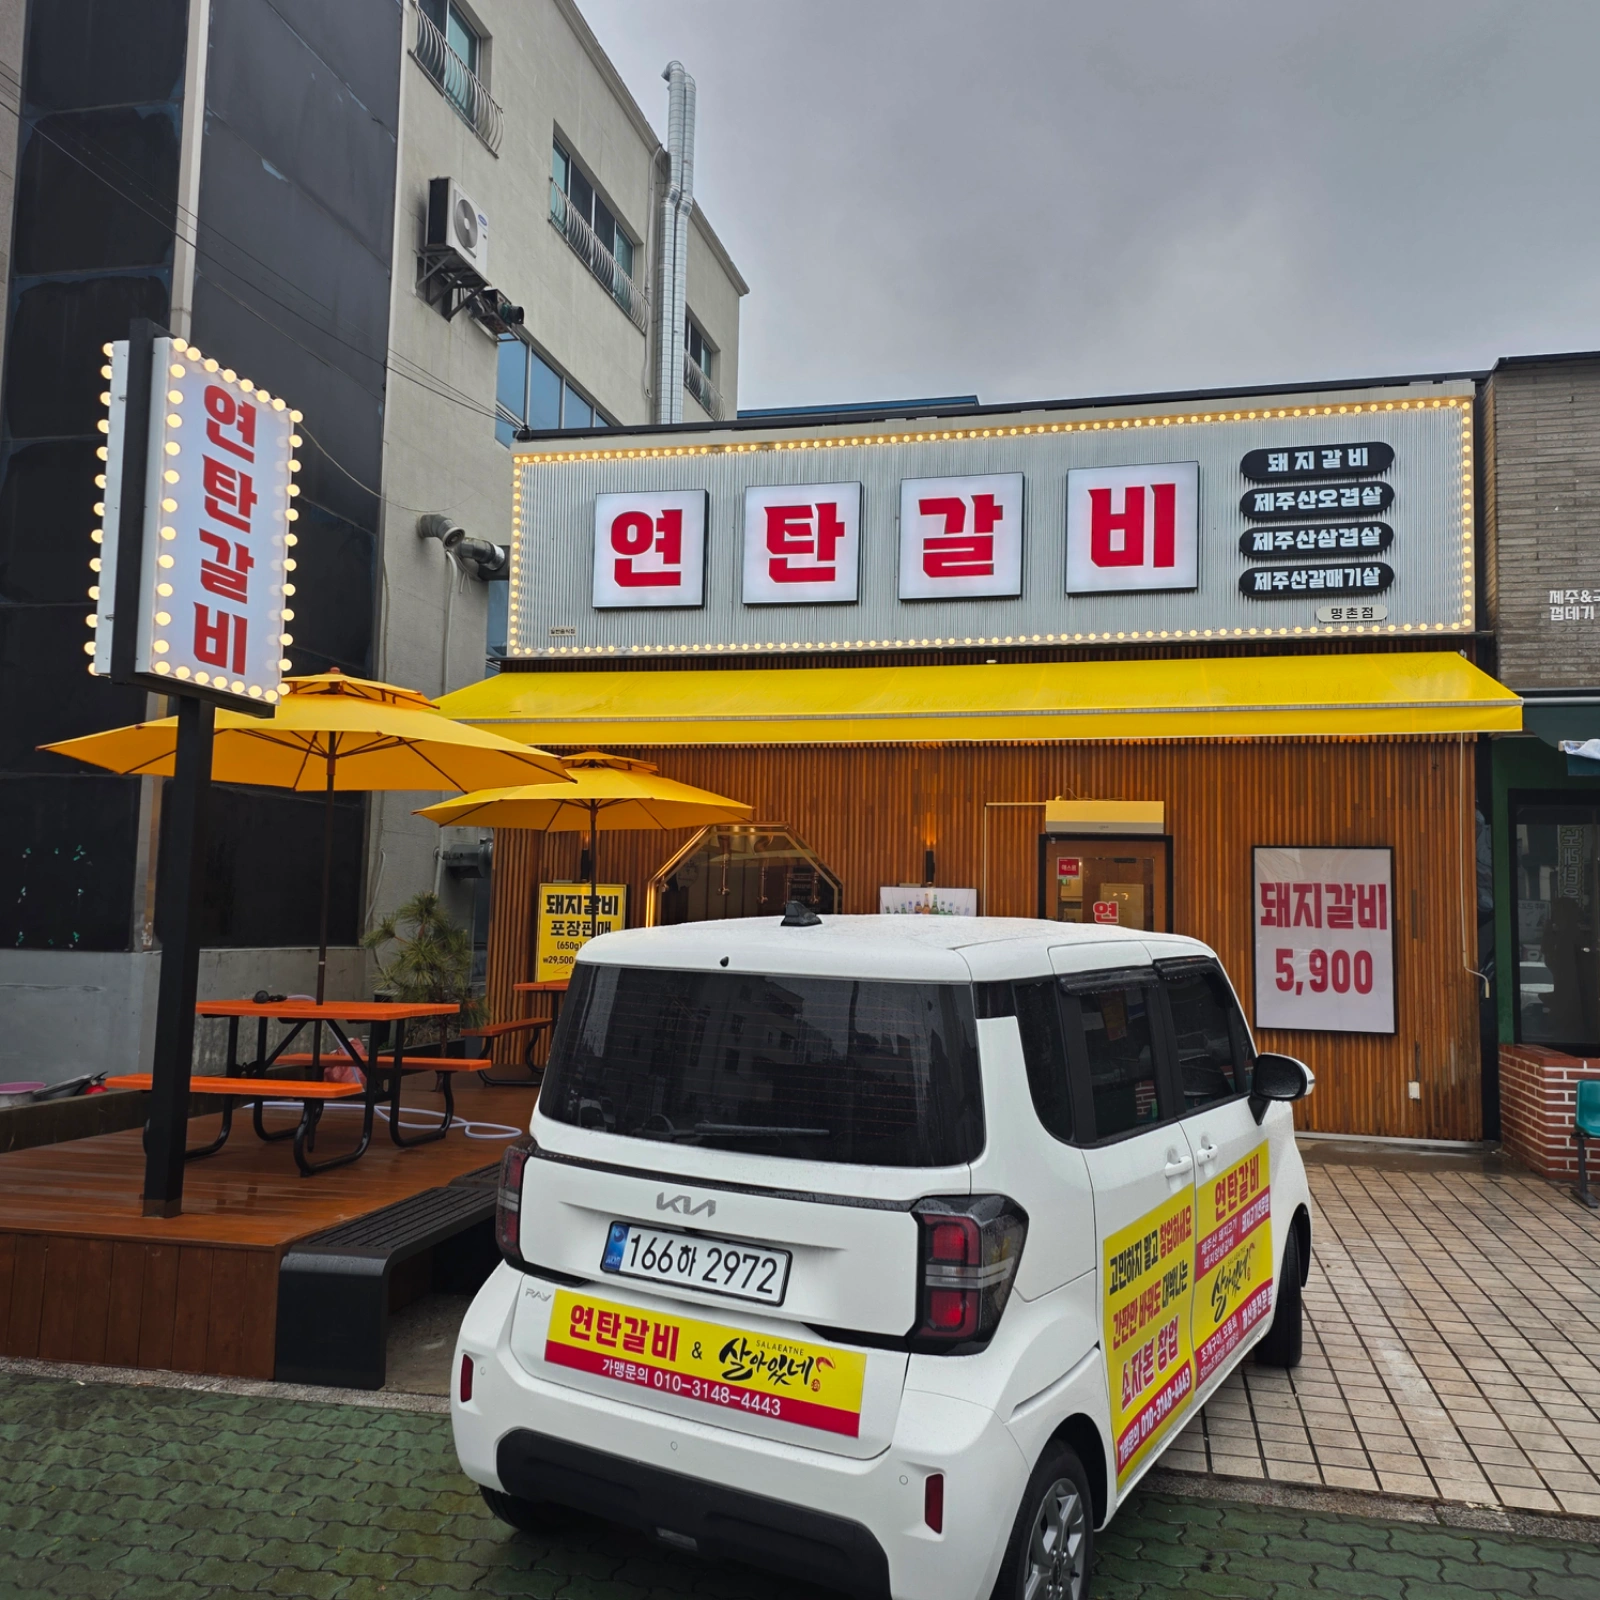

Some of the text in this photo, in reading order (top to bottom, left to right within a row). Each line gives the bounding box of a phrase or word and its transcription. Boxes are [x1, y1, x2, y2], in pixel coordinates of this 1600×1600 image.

[1267, 447, 1369, 472] 돼지갈비
[1254, 486, 1382, 512] 제주산오겹살
[192, 383, 258, 677] 연탄갈비
[610, 482, 1176, 588] 연탄갈비
[1252, 526, 1382, 551] 제주산삼겹살
[1254, 567, 1381, 591] 제주산갈매기살
[1331, 607, 1373, 619] 명촌점
[1549, 606, 1594, 620] 껍데기
[545, 894, 619, 916] 돼지갈비
[1260, 882, 1387, 930] 돼지갈비
[1275, 948, 1373, 996] 5,900
[656, 1192, 717, 1218] KIA
[1214, 1153, 1259, 1222] 연탄갈비
[630, 1233, 778, 1294] 166하 2972
[1109, 1239, 1143, 1296] 고민하지
[1160, 1204, 1192, 1260] 창업하세요
[525, 1287, 551, 1302] RAY
[569, 1304, 680, 1362] 연탄갈비
[691, 1341, 703, 1360] &
[602, 1358, 781, 1416] 가맹문의 010-3148-4443
[1121, 1315, 1179, 1413] 소자본 창업
[1140, 1367, 1191, 1437] 010-3148-4443
